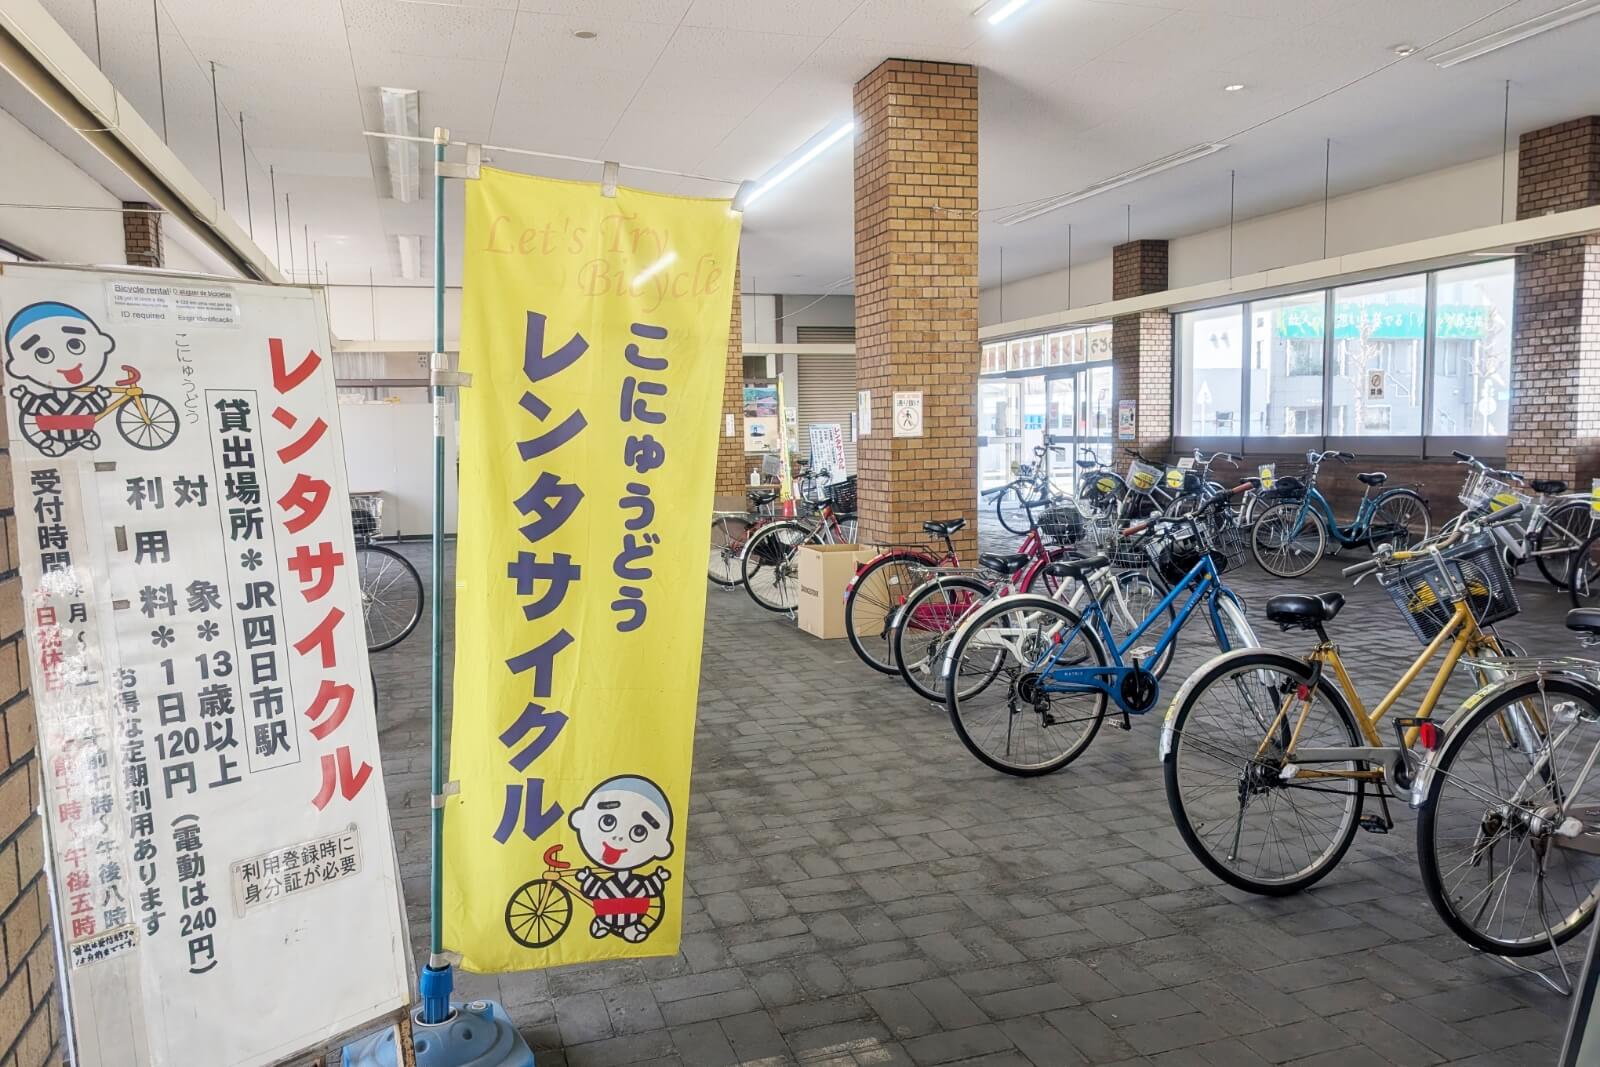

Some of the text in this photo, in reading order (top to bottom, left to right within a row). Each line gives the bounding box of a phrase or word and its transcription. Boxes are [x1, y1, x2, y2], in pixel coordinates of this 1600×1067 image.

[483, 213, 669, 259] Let's Try
[114, 284, 145, 294] Bicycle
[577, 253, 723, 314] Bicycle
[121, 311, 165, 321] ID required
[175, 332, 199, 424] こにゅうどう
[610, 322, 669, 632] こにゅうどう
[31, 468, 71, 574] 受付時間
[268, 337, 373, 811] レンタサイクル
[492, 310, 590, 845] レンタサイクル
[241, 836, 354, 883] 利用登録時に
[244, 854, 357, 905] 身分証が必要
